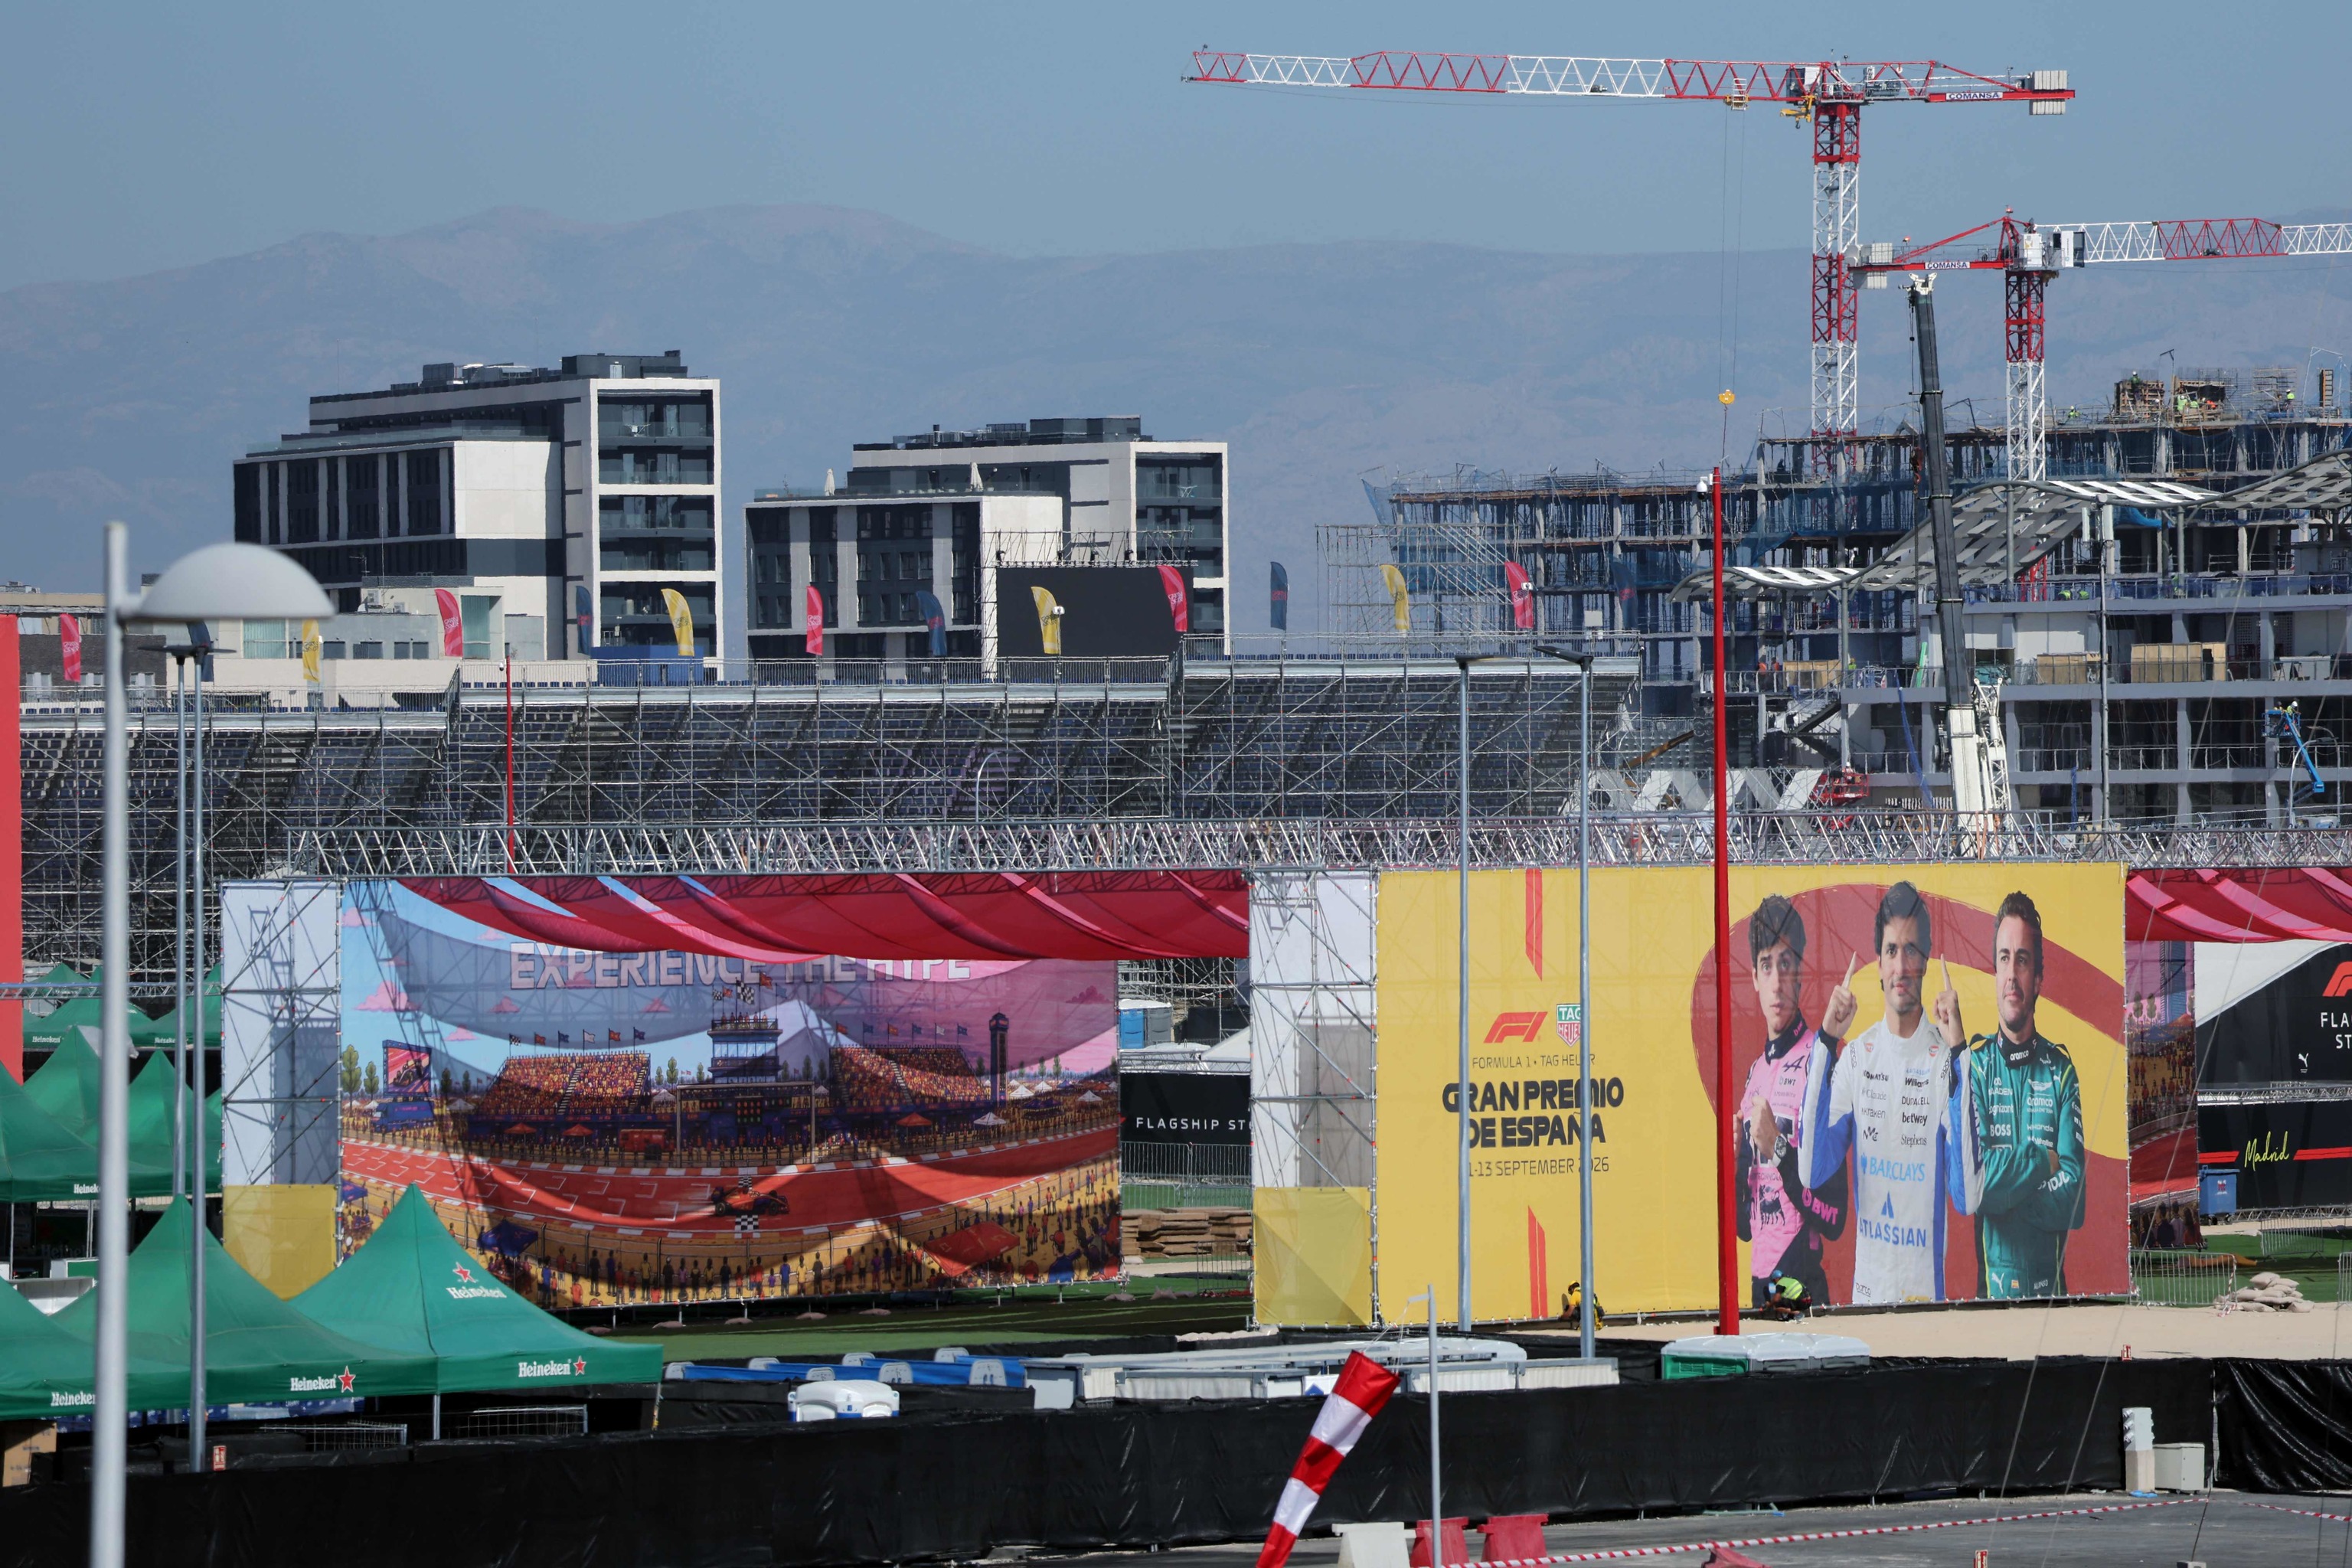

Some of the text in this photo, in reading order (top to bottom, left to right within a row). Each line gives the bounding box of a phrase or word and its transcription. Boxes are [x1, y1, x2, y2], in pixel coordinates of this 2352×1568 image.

[510, 942, 766, 989] EXPERIENCE
[1559, 1008, 1581, 1021] TAG
[2321, 1012, 2352, 1027] FLA
[1558, 1023, 1581, 1043] HEUE
[1472, 1054, 1596, 1070] FORMULA 1 TAG HEUR
[2010, 1050, 2029, 1061] aramco
[1783, 1077, 1796, 1086] BWT
[1442, 1077, 1624, 1112] GRAN PREMIO
[2027, 1097, 2053, 1107] aramco
[1989, 1103, 2014, 1116] ognizant
[1136, 1117, 1220, 1130] FLAGSHIP
[1902, 1112, 1928, 1126] betway
[1990, 1124, 2011, 1137] BOSS
[1901, 1135, 1927, 1148] Stephens
[2244, 1131, 2290, 1171] Madrid
[1496, 1158, 1574, 1176] SEPTEMBER
[1578, 1157, 1609, 1173] 26
[1870, 1156, 1926, 1182] BARCLAYS
[74, 1183, 100, 1194] Heinek
[1811, 1197, 1838, 1225] BWT
[1859, 1217, 1926, 1248] ATLASSIAN
[446, 1285, 507, 1299] Heineken
[518, 1360, 571, 1377] Heineken
[290, 1376, 337, 1391] Heineken
